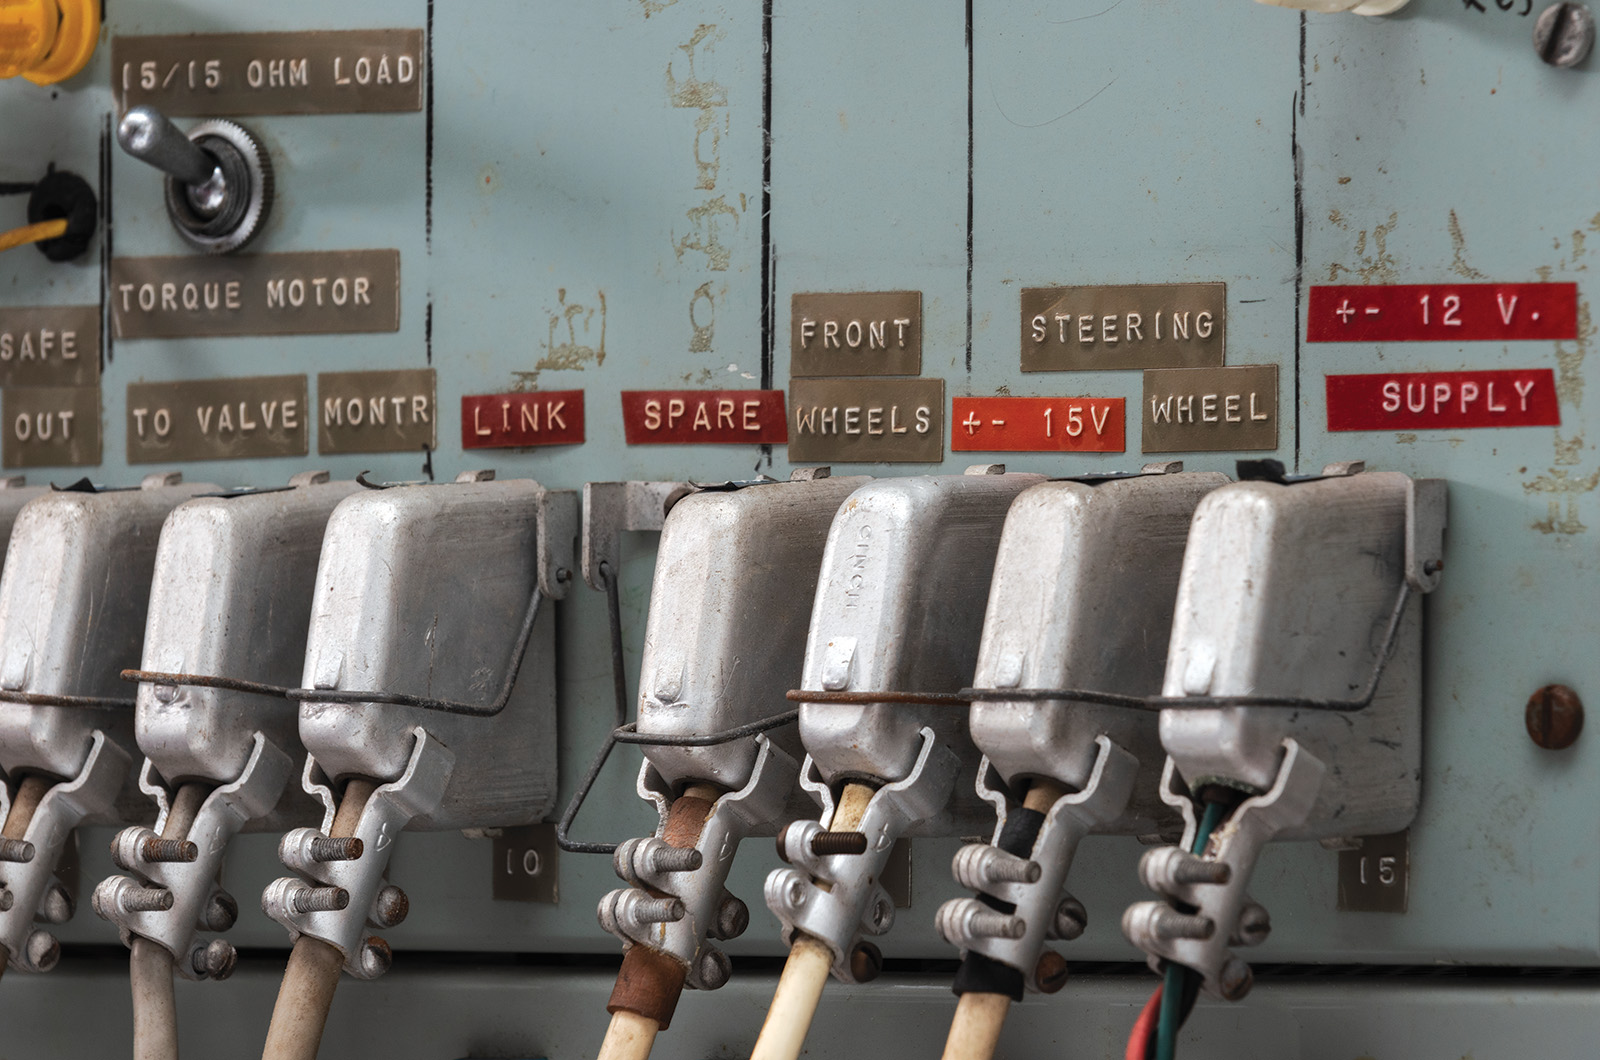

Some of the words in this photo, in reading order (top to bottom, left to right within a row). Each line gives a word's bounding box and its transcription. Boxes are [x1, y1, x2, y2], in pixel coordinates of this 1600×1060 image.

[122, 60, 222, 90] 15/15
[247, 59, 309, 89] OHM
[333, 54, 415, 86] LOAD
[119, 281, 242, 313] TORQUE
[266, 277, 371, 308] MOTOR
[1419, 294, 1463, 326] 12
[801, 317, 911, 349] FRONT
[1030, 310, 1214, 343] STEERING
[0, 329, 78, 361] SAFE
[322, 395, 431, 428] MONTR
[1150, 392, 1268, 426] WHEEL
[1382, 380, 1535, 414] SUPPLY
[14, 411, 75, 442] OUT
[133, 408, 171, 438] TO
[197, 399, 299, 435] VALVE
[474, 400, 567, 435] LINK
[643, 399, 762, 431] SPARE
[795, 405, 931, 436] WHEELS
[1042, 404, 1111, 438] 15V
[506, 848, 540, 876] 10
[1360, 856, 1396, 885] 15
